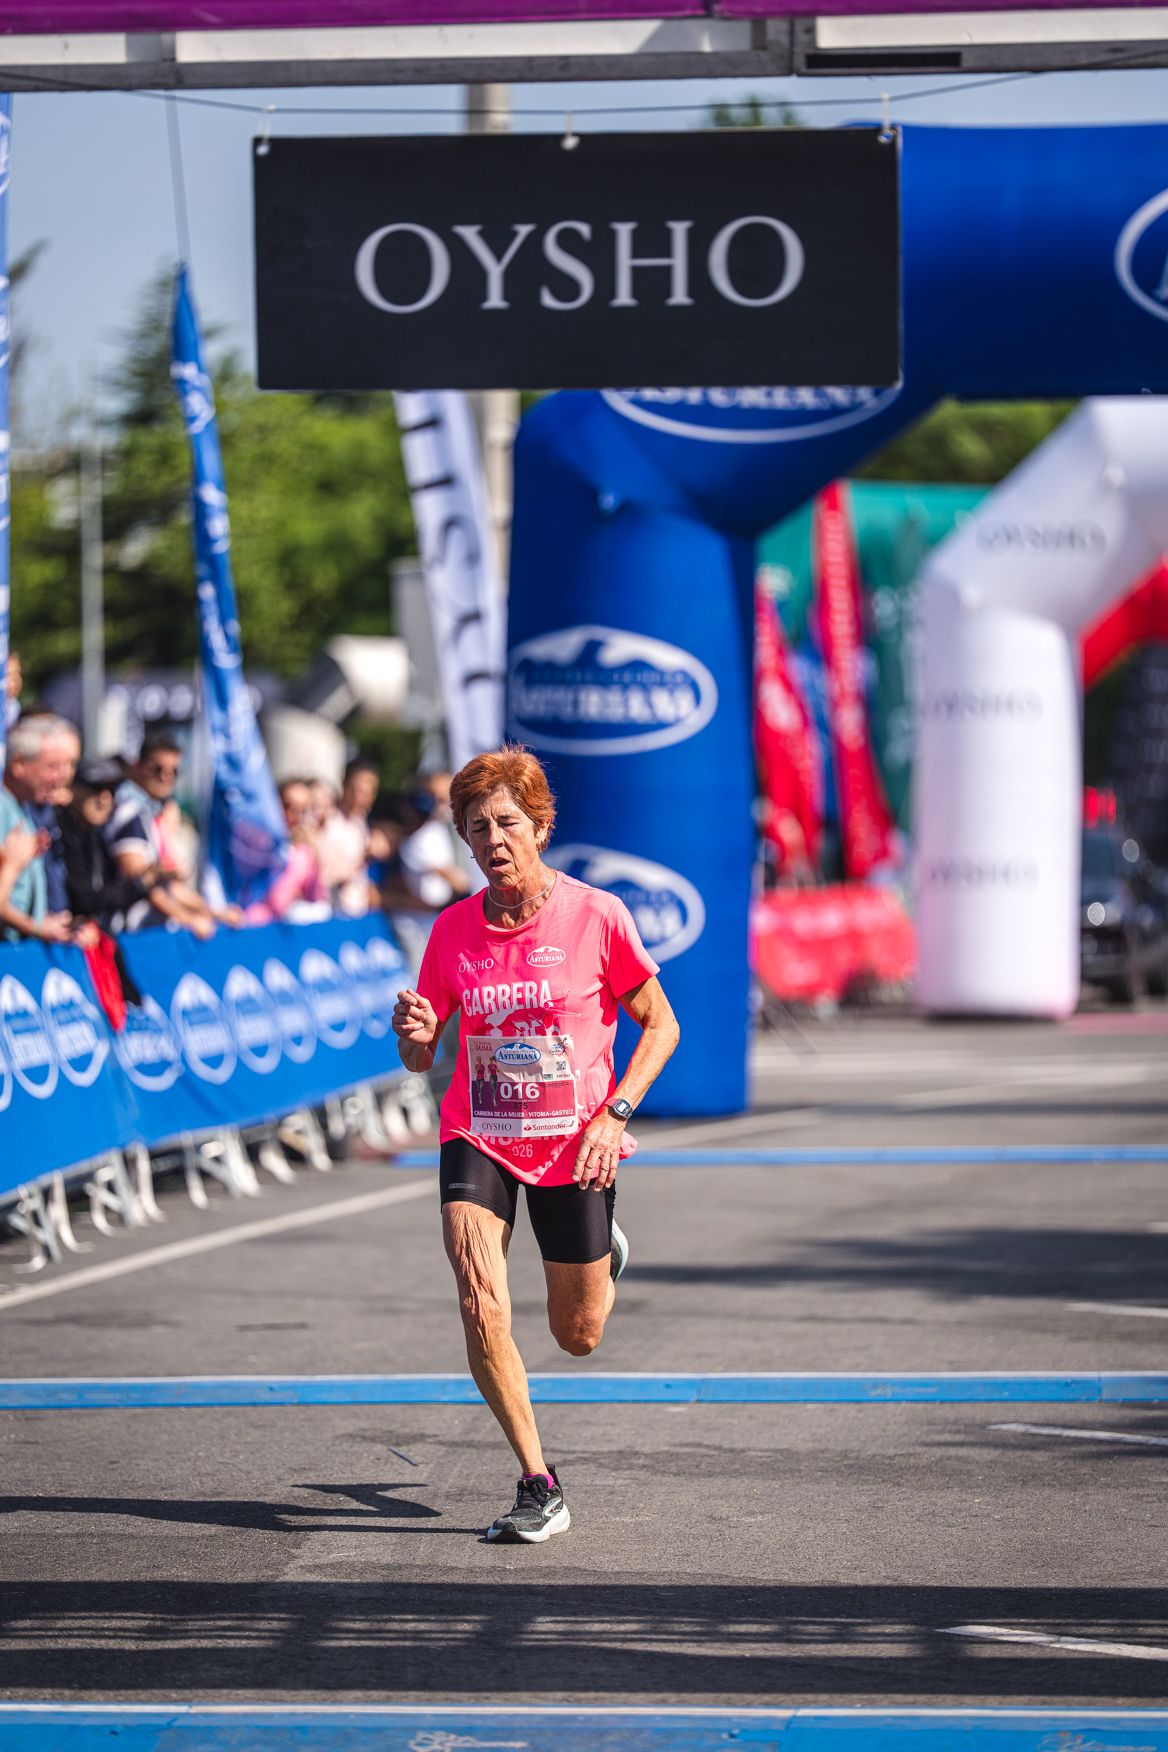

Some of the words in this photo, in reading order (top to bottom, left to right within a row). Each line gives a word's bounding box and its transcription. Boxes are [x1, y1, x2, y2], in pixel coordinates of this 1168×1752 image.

[354, 215, 805, 314] OYSHO
[530, 953, 562, 963] ASTURIANA
[458, 957, 494, 973] OYSHO
[462, 980, 554, 1017] CARRERA
[498, 1051, 538, 1060] ASTURIANA
[500, 1082, 540, 1099] 016
[481, 1121, 512, 1132] OYSHO
[532, 1123, 566, 1131] Santander
